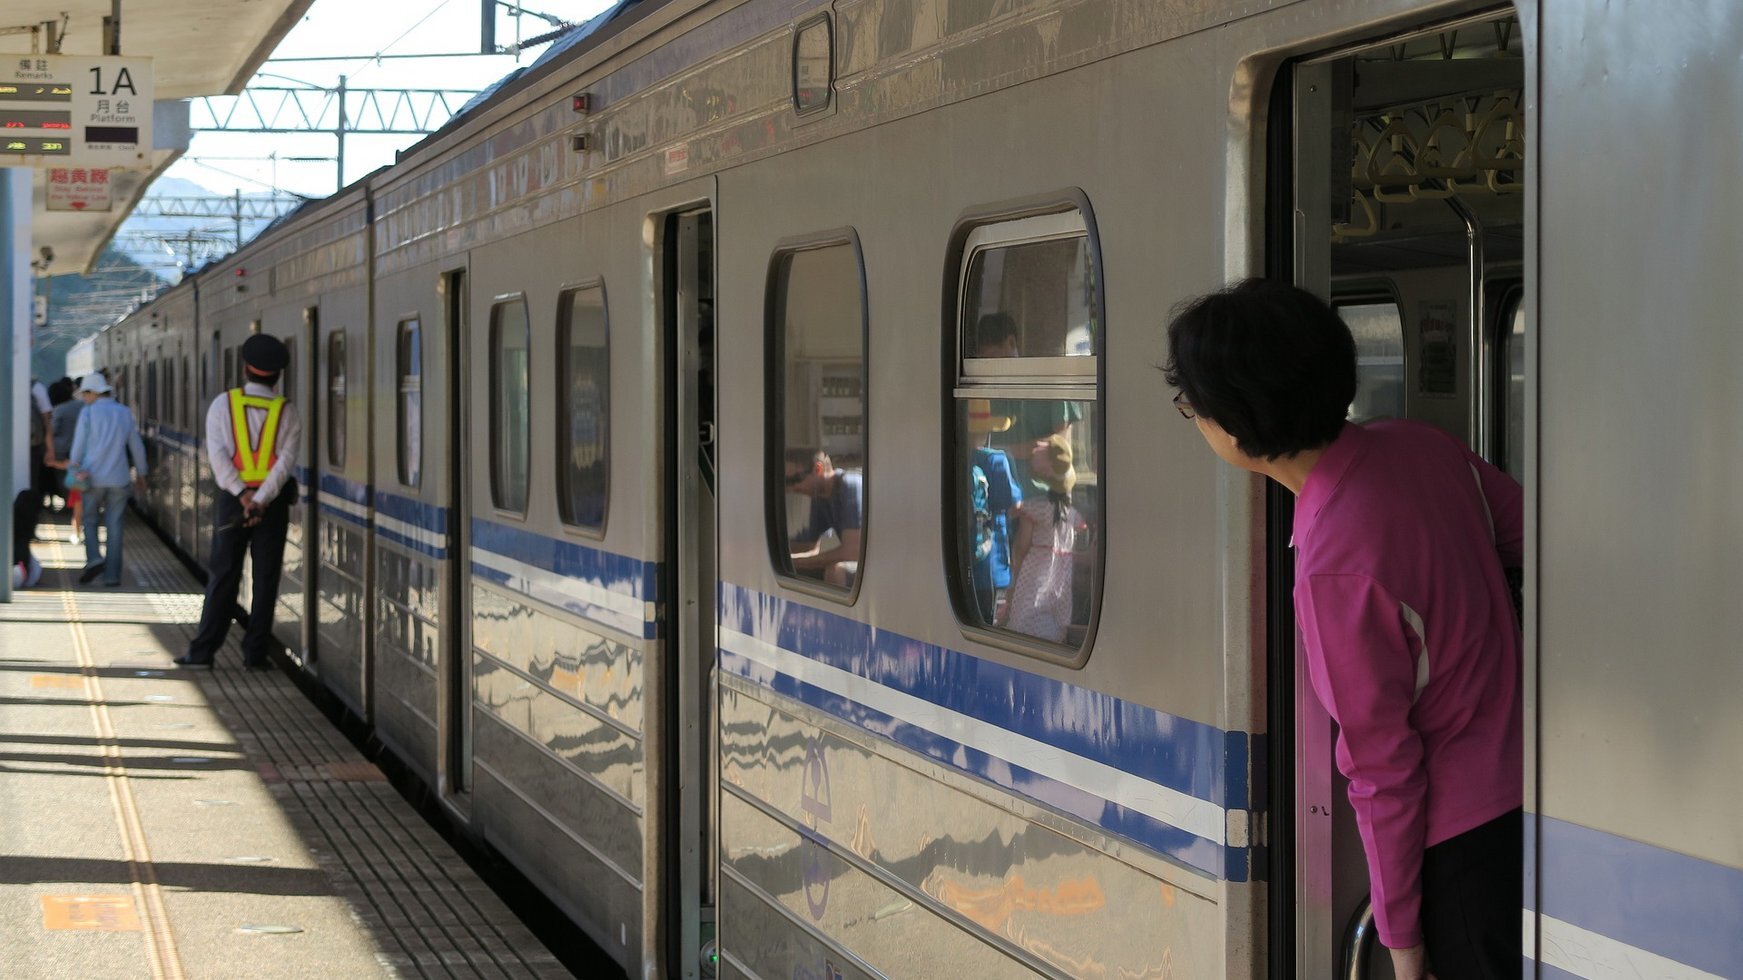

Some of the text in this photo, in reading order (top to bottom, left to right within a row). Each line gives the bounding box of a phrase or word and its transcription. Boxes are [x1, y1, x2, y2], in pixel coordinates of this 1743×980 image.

[15, 71, 53, 79] Remarks
[89, 66, 137, 96] 1A
[96, 99, 130, 114] 月台
[90, 114, 136, 123] Platform
